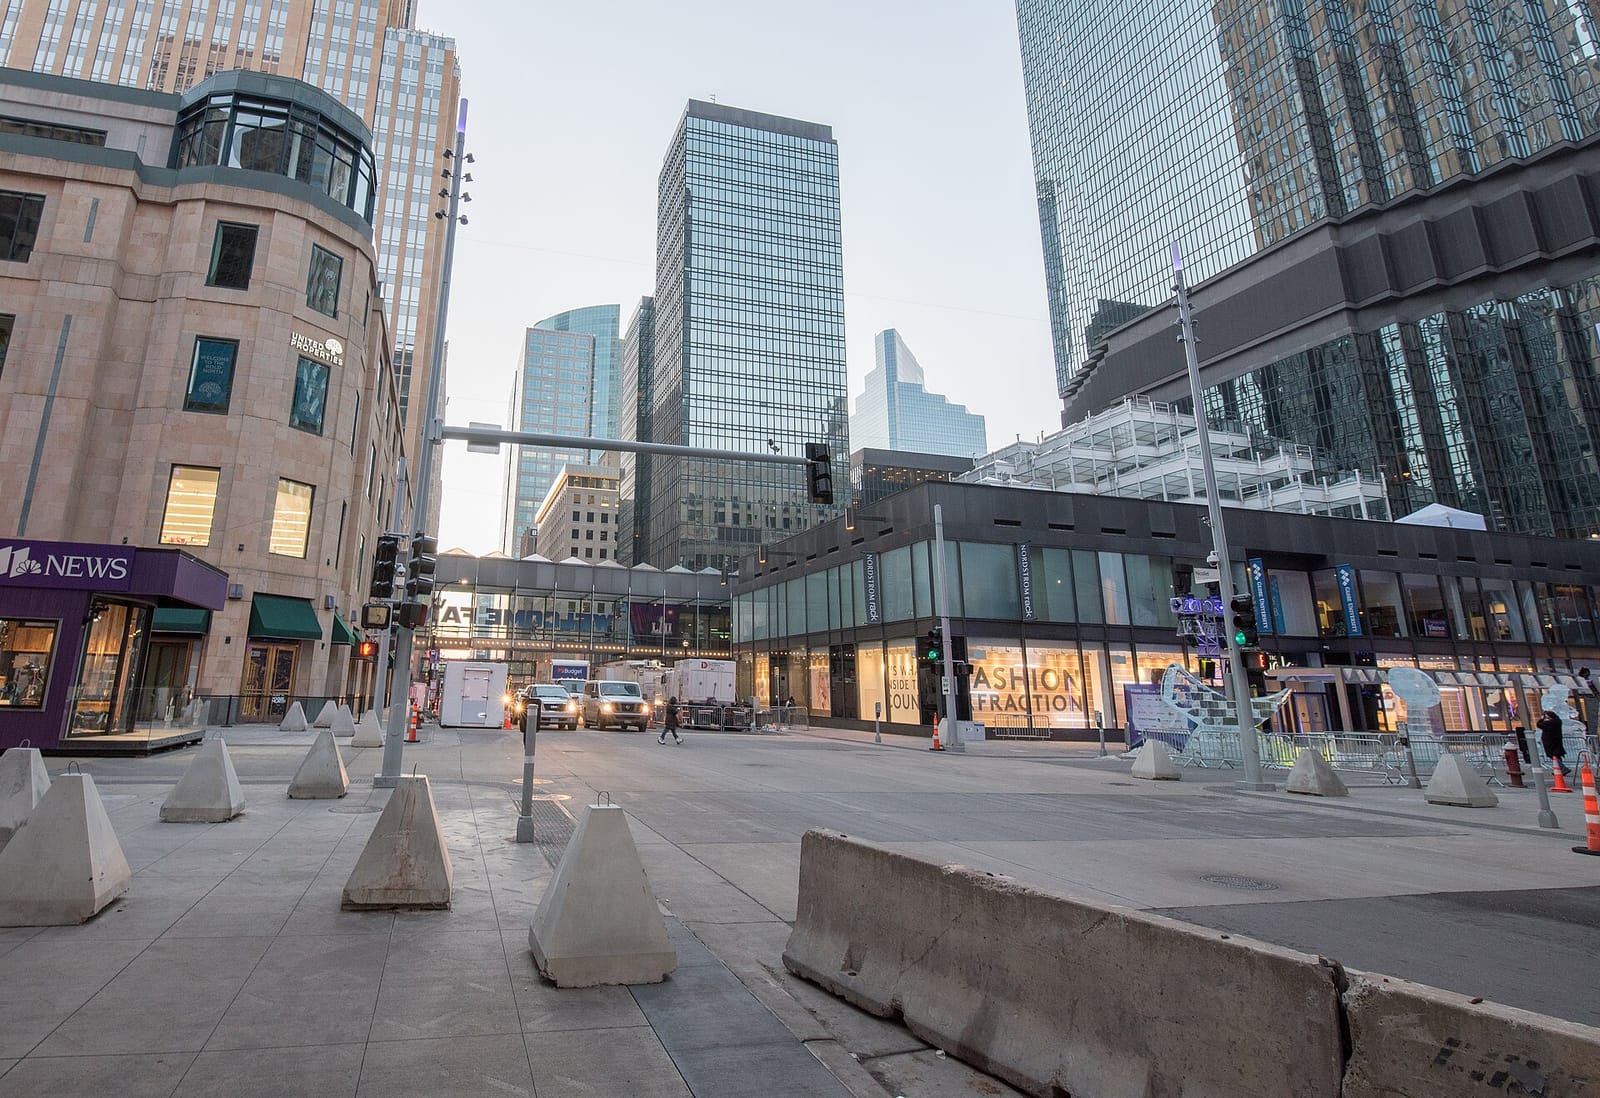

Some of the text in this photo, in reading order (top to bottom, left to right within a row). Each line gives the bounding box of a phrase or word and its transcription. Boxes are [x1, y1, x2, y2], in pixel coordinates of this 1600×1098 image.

[290, 338, 343, 367] PROPERTIES
[291, 331, 324, 351] UNITED
[43, 554, 128, 580] NEWS
[866, 554, 879, 621] NORDSTROM rack
[1020, 544, 1033, 618] NORDSTROM rack
[564, 667, 583, 676] Budget
